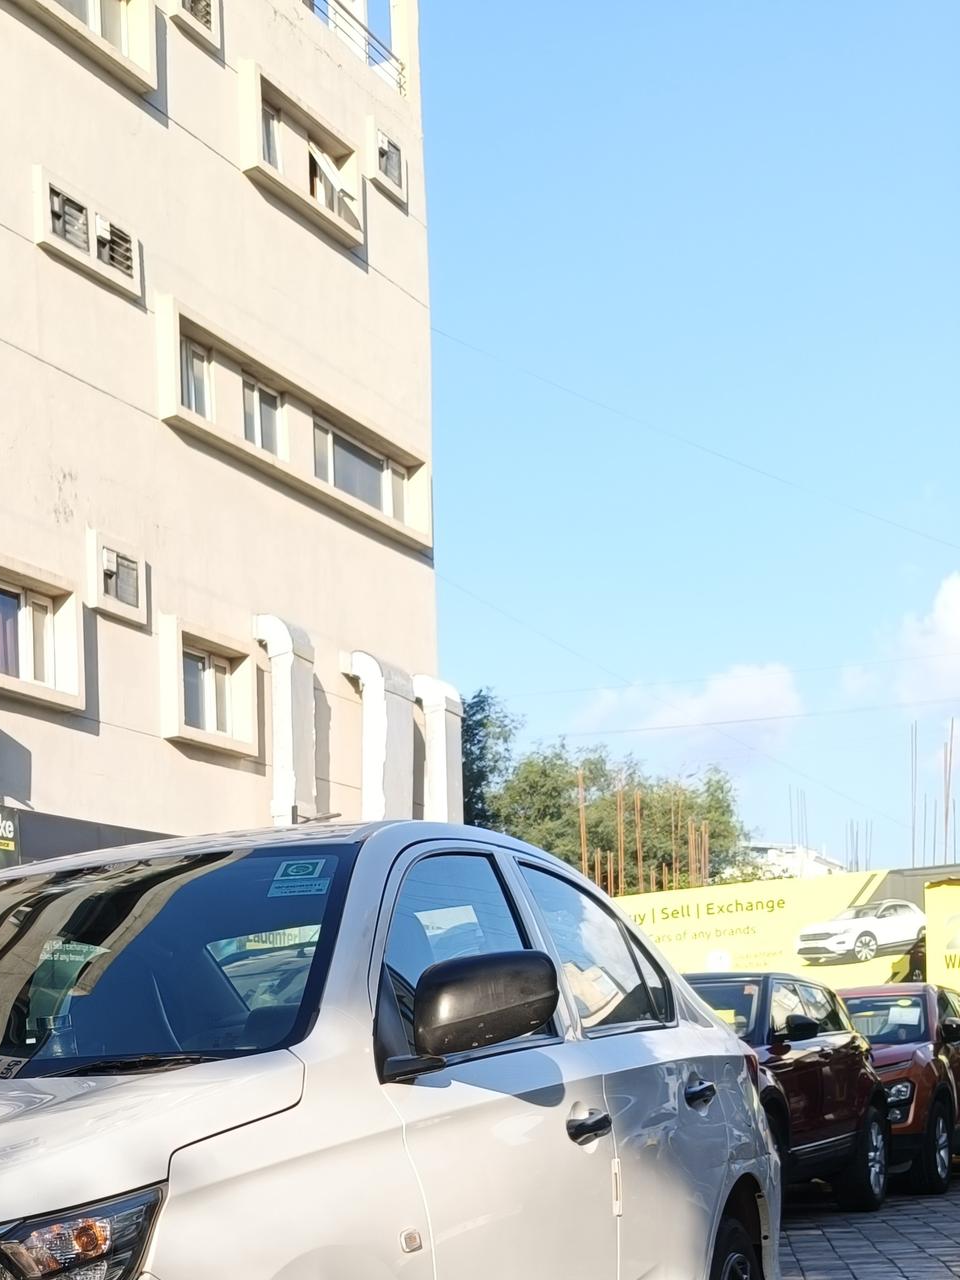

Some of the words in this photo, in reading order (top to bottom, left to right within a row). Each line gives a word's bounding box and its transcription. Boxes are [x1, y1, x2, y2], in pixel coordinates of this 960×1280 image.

[628, 912, 646, 926] uy
[661, 904, 691, 920] Sell
[706, 898, 786, 916] Exchange
[649, 934, 672, 944] ars
[675, 930, 688, 942] of
[692, 931, 712, 941] any
[715, 925, 757, 937] brands
